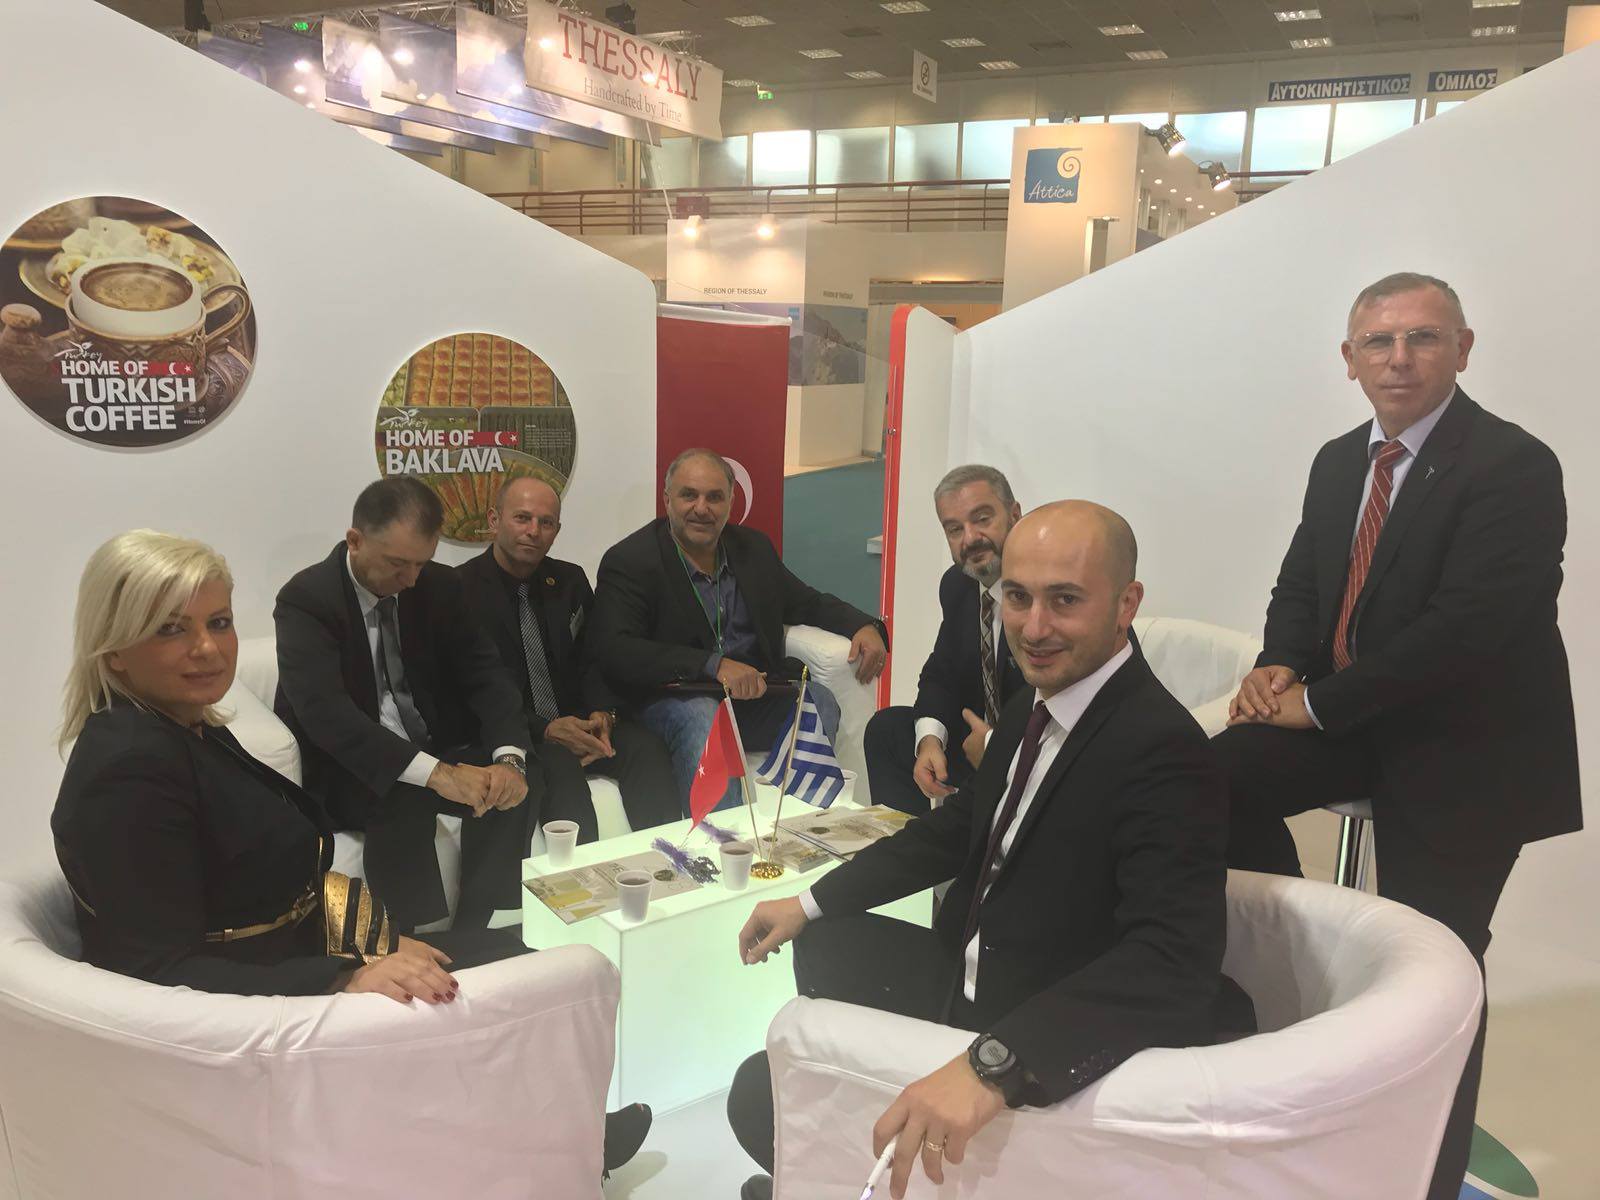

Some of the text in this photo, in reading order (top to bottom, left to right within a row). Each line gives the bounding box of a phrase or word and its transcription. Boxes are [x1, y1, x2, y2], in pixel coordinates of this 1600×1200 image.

[558, 13, 701, 100] THESSALY
[1435, 72, 1498, 90] ΟΜΙΛΟΣ
[584, 77, 682, 122] Handcrafted by Time
[1028, 179, 1074, 201] Attica
[703, 287, 768, 295] REGION OF THESSALY
[61, 360, 149, 375] HOME OF
[61, 377, 197, 403] TURKISH
[65, 405, 176, 432] COFFEE
[386, 430, 475, 447] HOME OF
[386, 448, 504, 474] BAKLAVA
